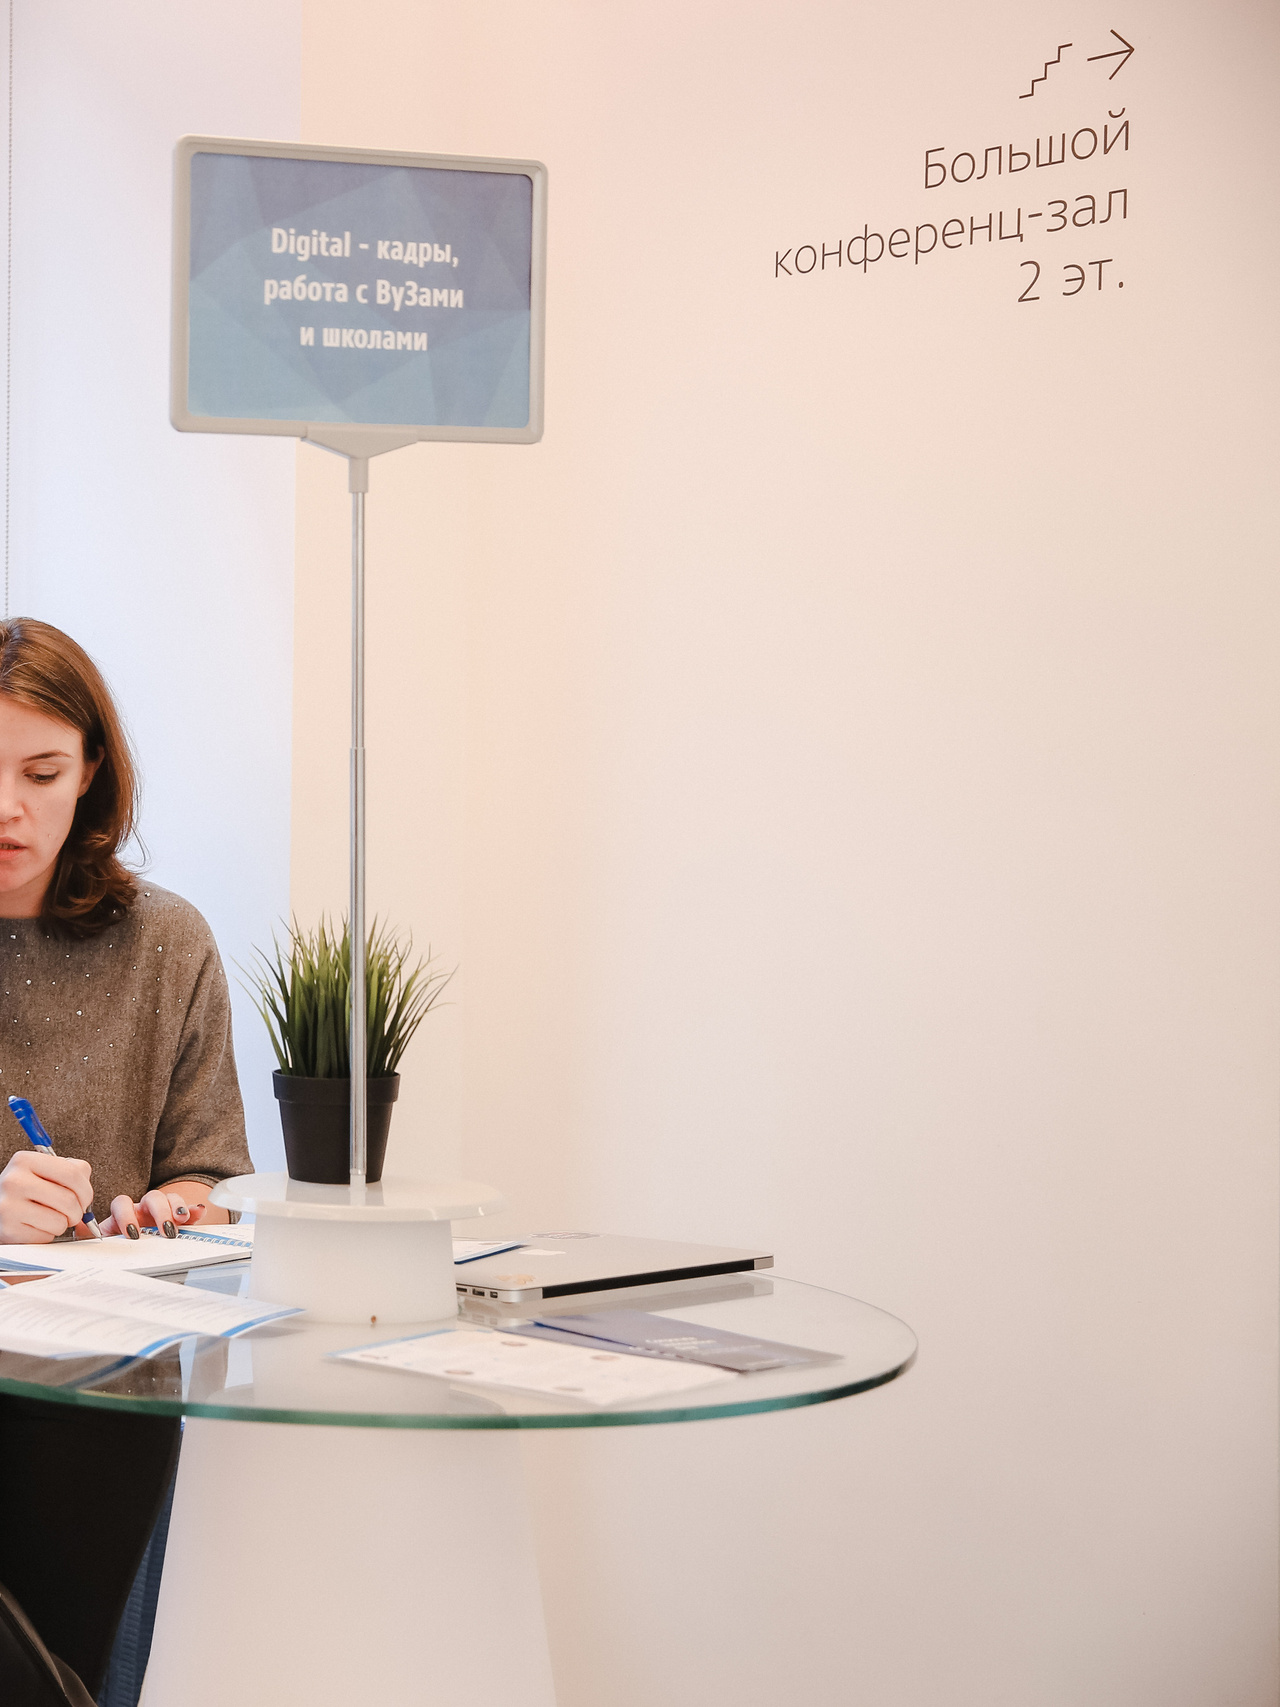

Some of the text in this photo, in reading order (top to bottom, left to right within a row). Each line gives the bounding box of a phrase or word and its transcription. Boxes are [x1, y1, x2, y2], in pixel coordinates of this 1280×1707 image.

[924, 107, 1130, 189] Большой
[271, 228, 351, 262] Digital
[377, 239, 459, 267] кадры,
[774, 188, 1128, 278] конференц-зал
[264, 274, 464, 311] работа с ВуЗами
[1017, 258, 1124, 303] 2 эт.
[299, 326, 428, 351] и школами
